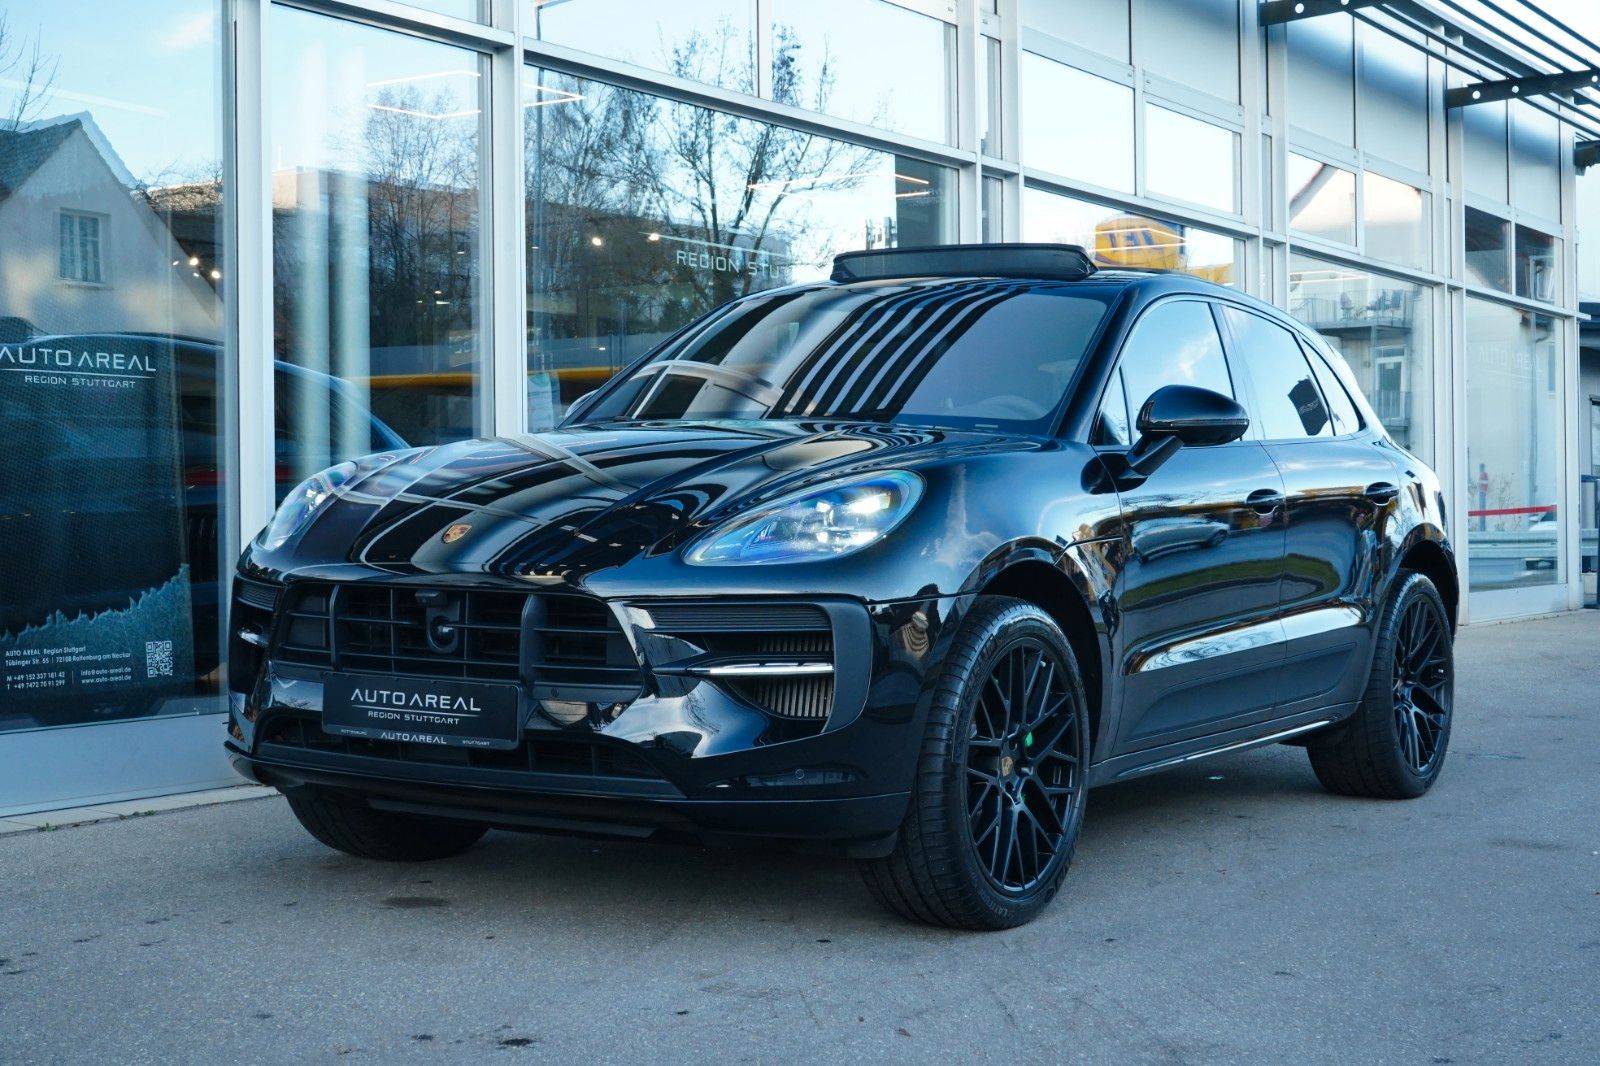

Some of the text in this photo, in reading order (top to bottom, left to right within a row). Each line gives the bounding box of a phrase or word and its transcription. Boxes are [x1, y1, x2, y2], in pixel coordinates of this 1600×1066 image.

[676, 250, 740, 274] REGION
[25, 375, 136, 389] REGION STUTTGART
[368, 710, 460, 725] REGION STUTTGART
